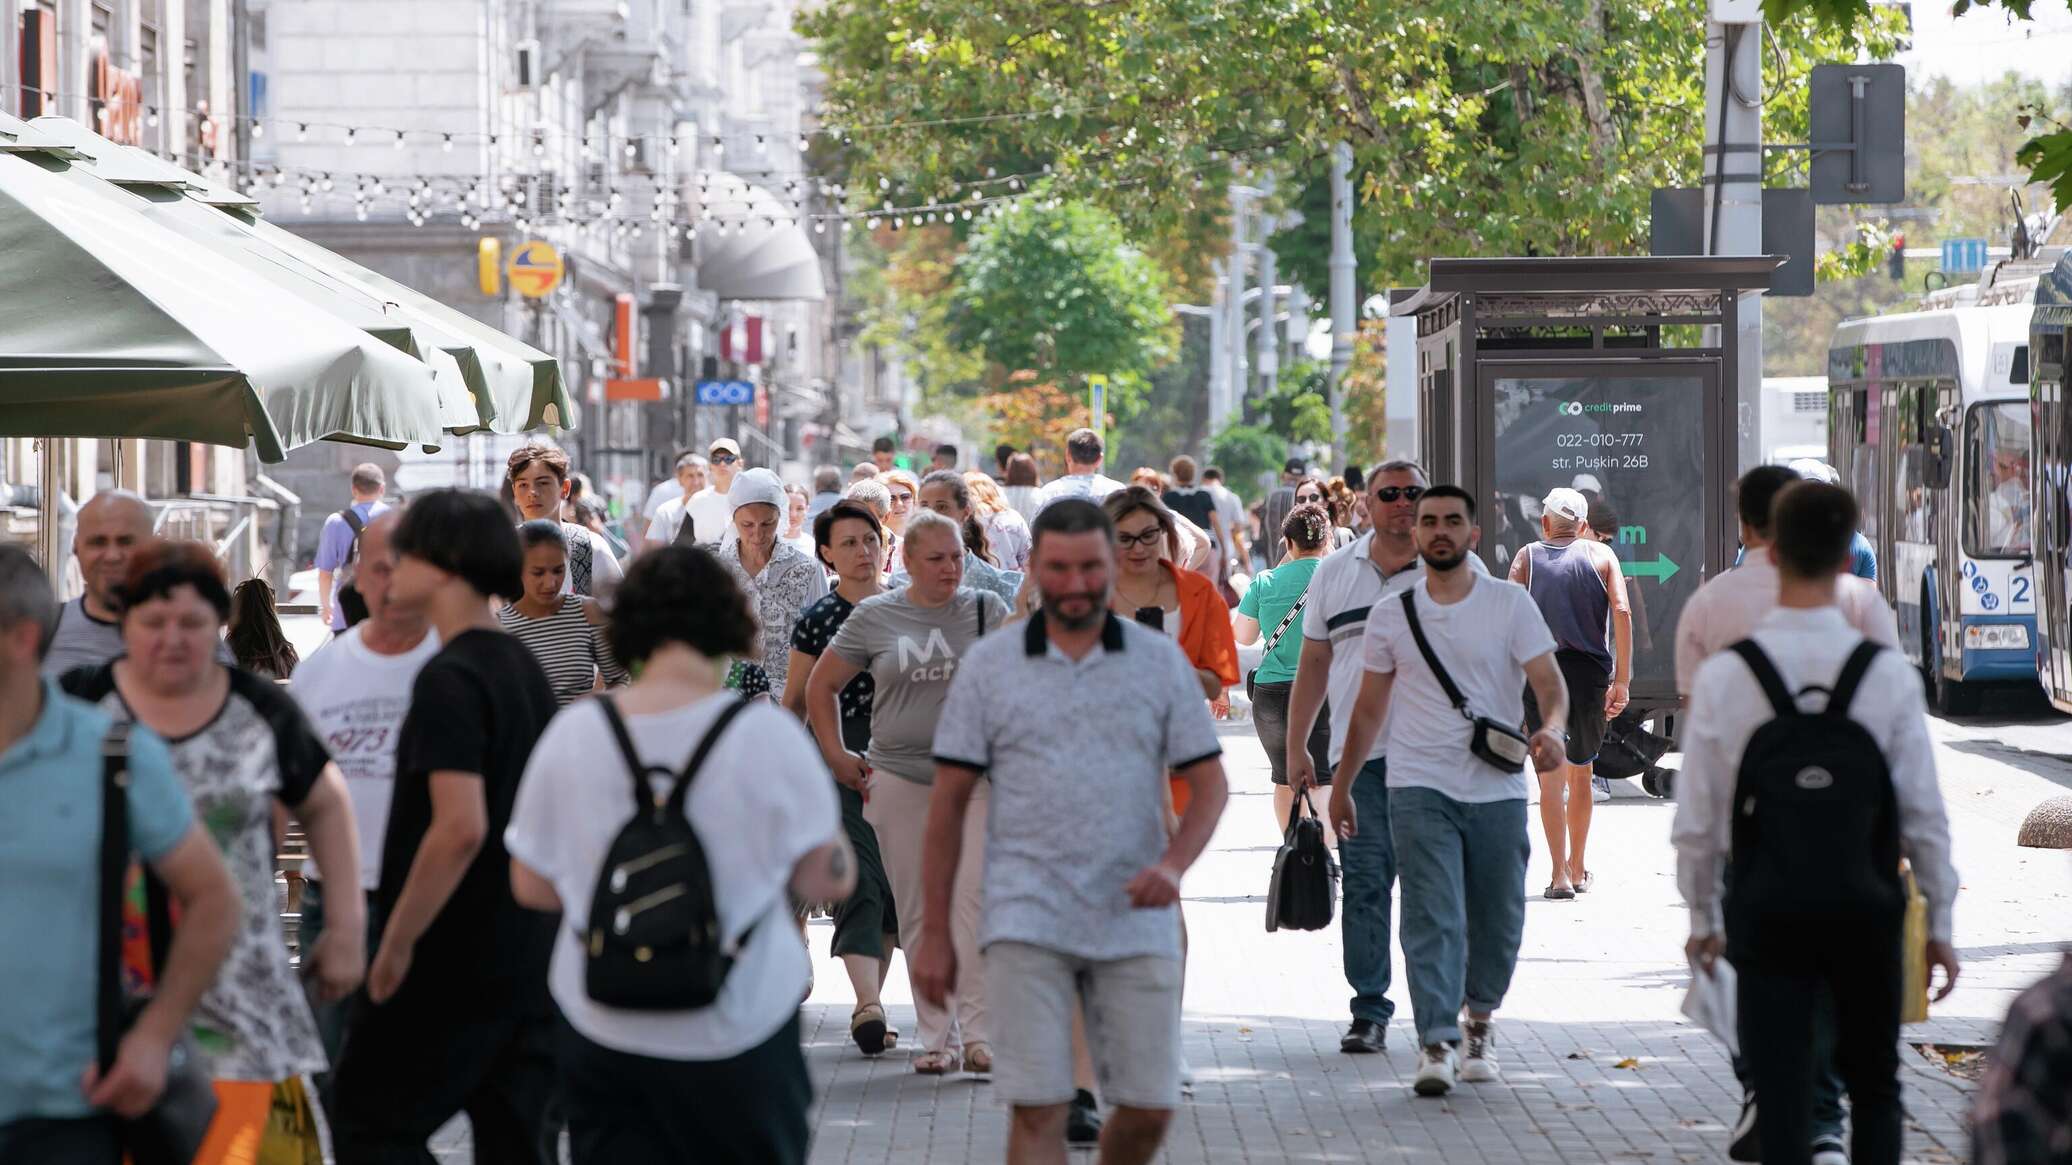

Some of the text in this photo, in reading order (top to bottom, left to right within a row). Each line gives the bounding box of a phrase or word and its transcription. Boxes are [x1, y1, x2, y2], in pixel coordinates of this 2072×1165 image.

[1556, 433, 1644, 448] 022-010-777
[1552, 455, 1649, 472] str. Pușkin 26B
